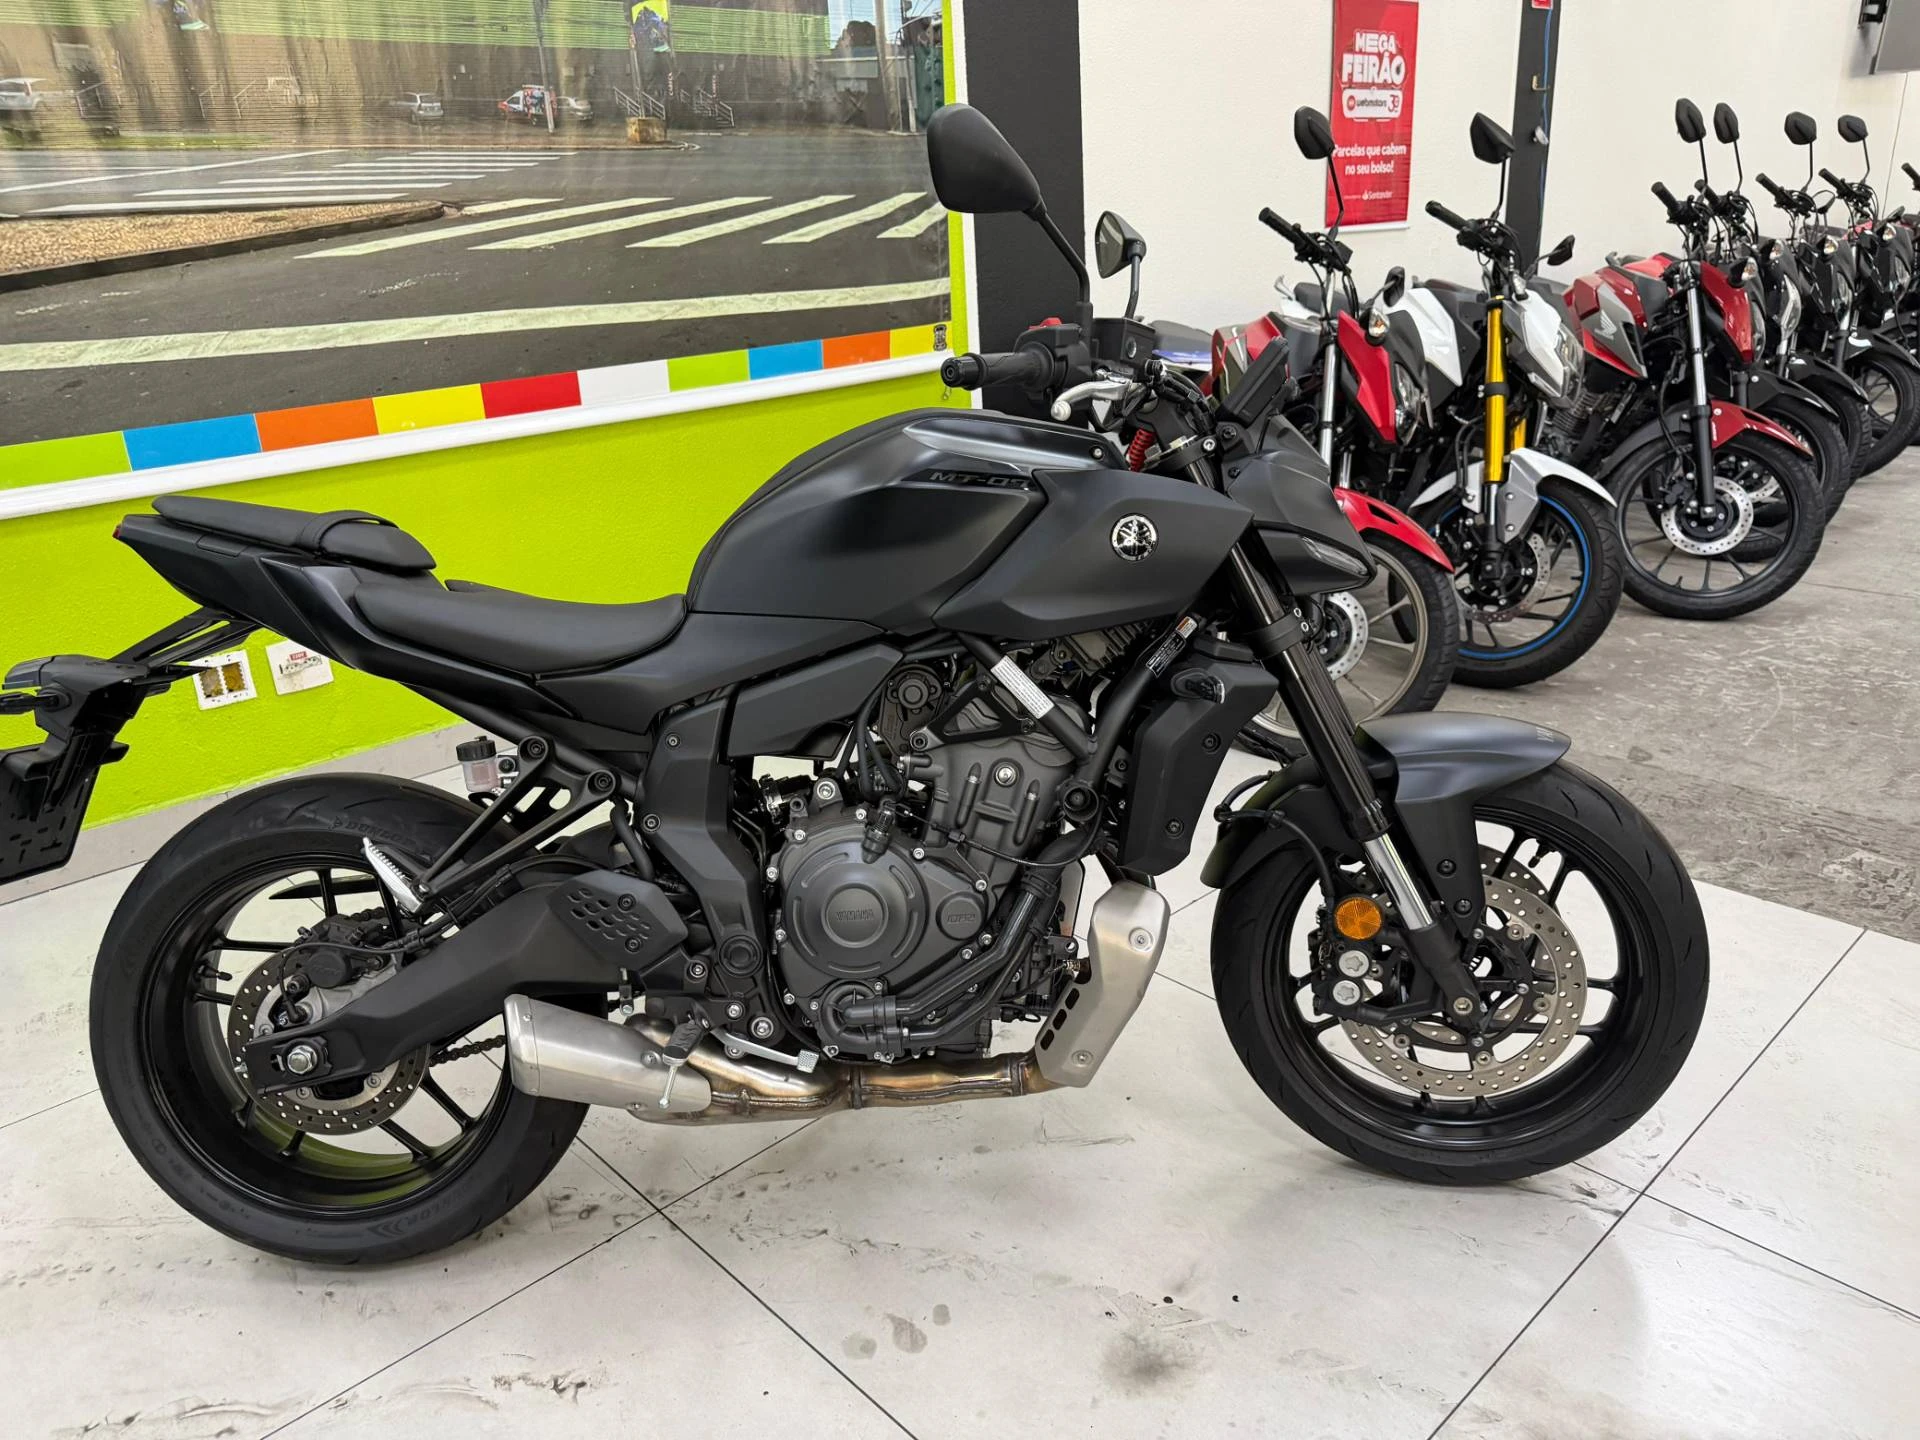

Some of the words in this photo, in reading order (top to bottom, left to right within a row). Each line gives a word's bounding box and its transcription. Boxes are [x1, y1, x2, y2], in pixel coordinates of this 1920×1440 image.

[1355, 32, 1397, 54] MEGA
[1342, 50, 1405, 85] FEIRÃO
[1333, 144, 1365, 157] Parcelas
[1366, 146, 1380, 159] que
[1381, 142, 1407, 155] cabem
[1345, 165, 1356, 176] no
[1357, 164, 1370, 175] seu
[1371, 160, 1394, 174] bolso!
[1368, 190, 1393, 200] Santander
[836, 908, 875, 921] YAMAHA
